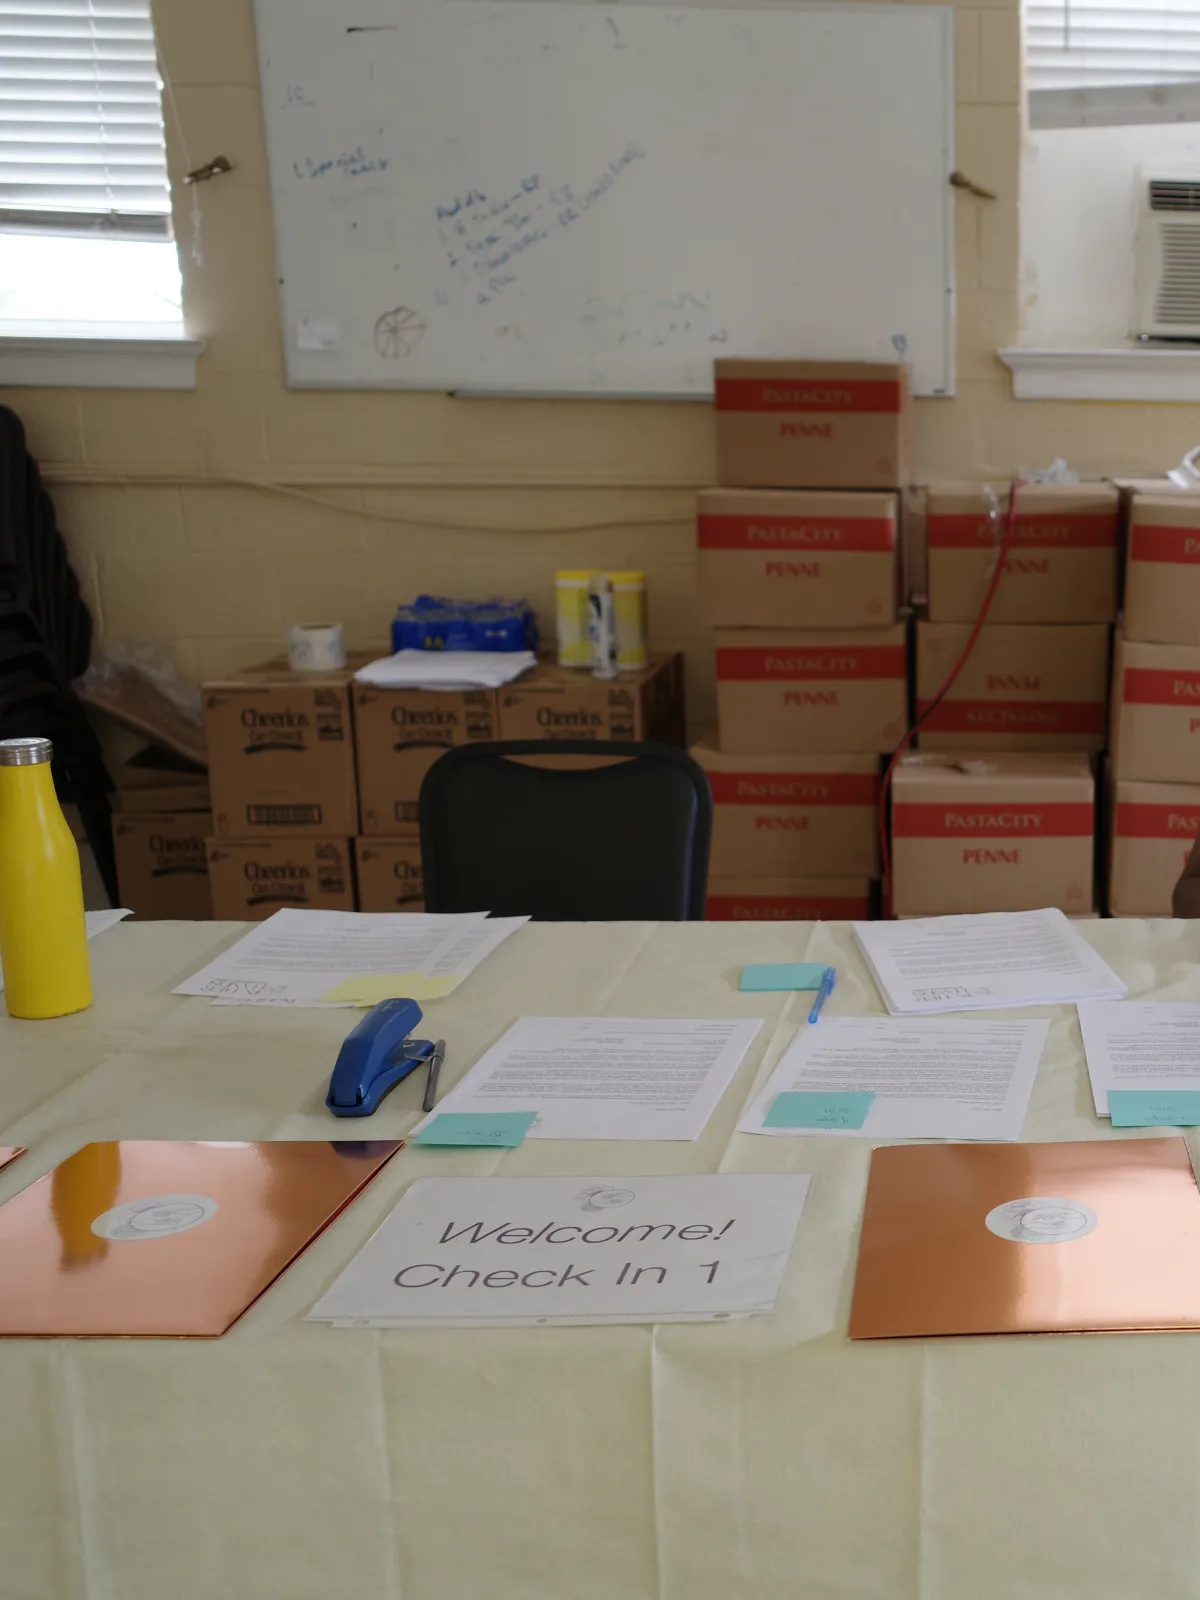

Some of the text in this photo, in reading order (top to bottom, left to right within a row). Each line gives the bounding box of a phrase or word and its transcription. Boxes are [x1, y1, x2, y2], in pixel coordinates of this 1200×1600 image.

[779, 421, 834, 438] PENNE
[765, 561, 822, 577] PENNE
[783, 690, 839, 706] PENNE
[241, 707, 310, 727] Cheerios
[390, 705, 460, 725] Cheerios
[754, 815, 810, 831] PENNE
[962, 848, 1022, 865] PENNE
[438, 1218, 737, 1245] Welcome!
[393, 1260, 721, 1289] Check In 1
